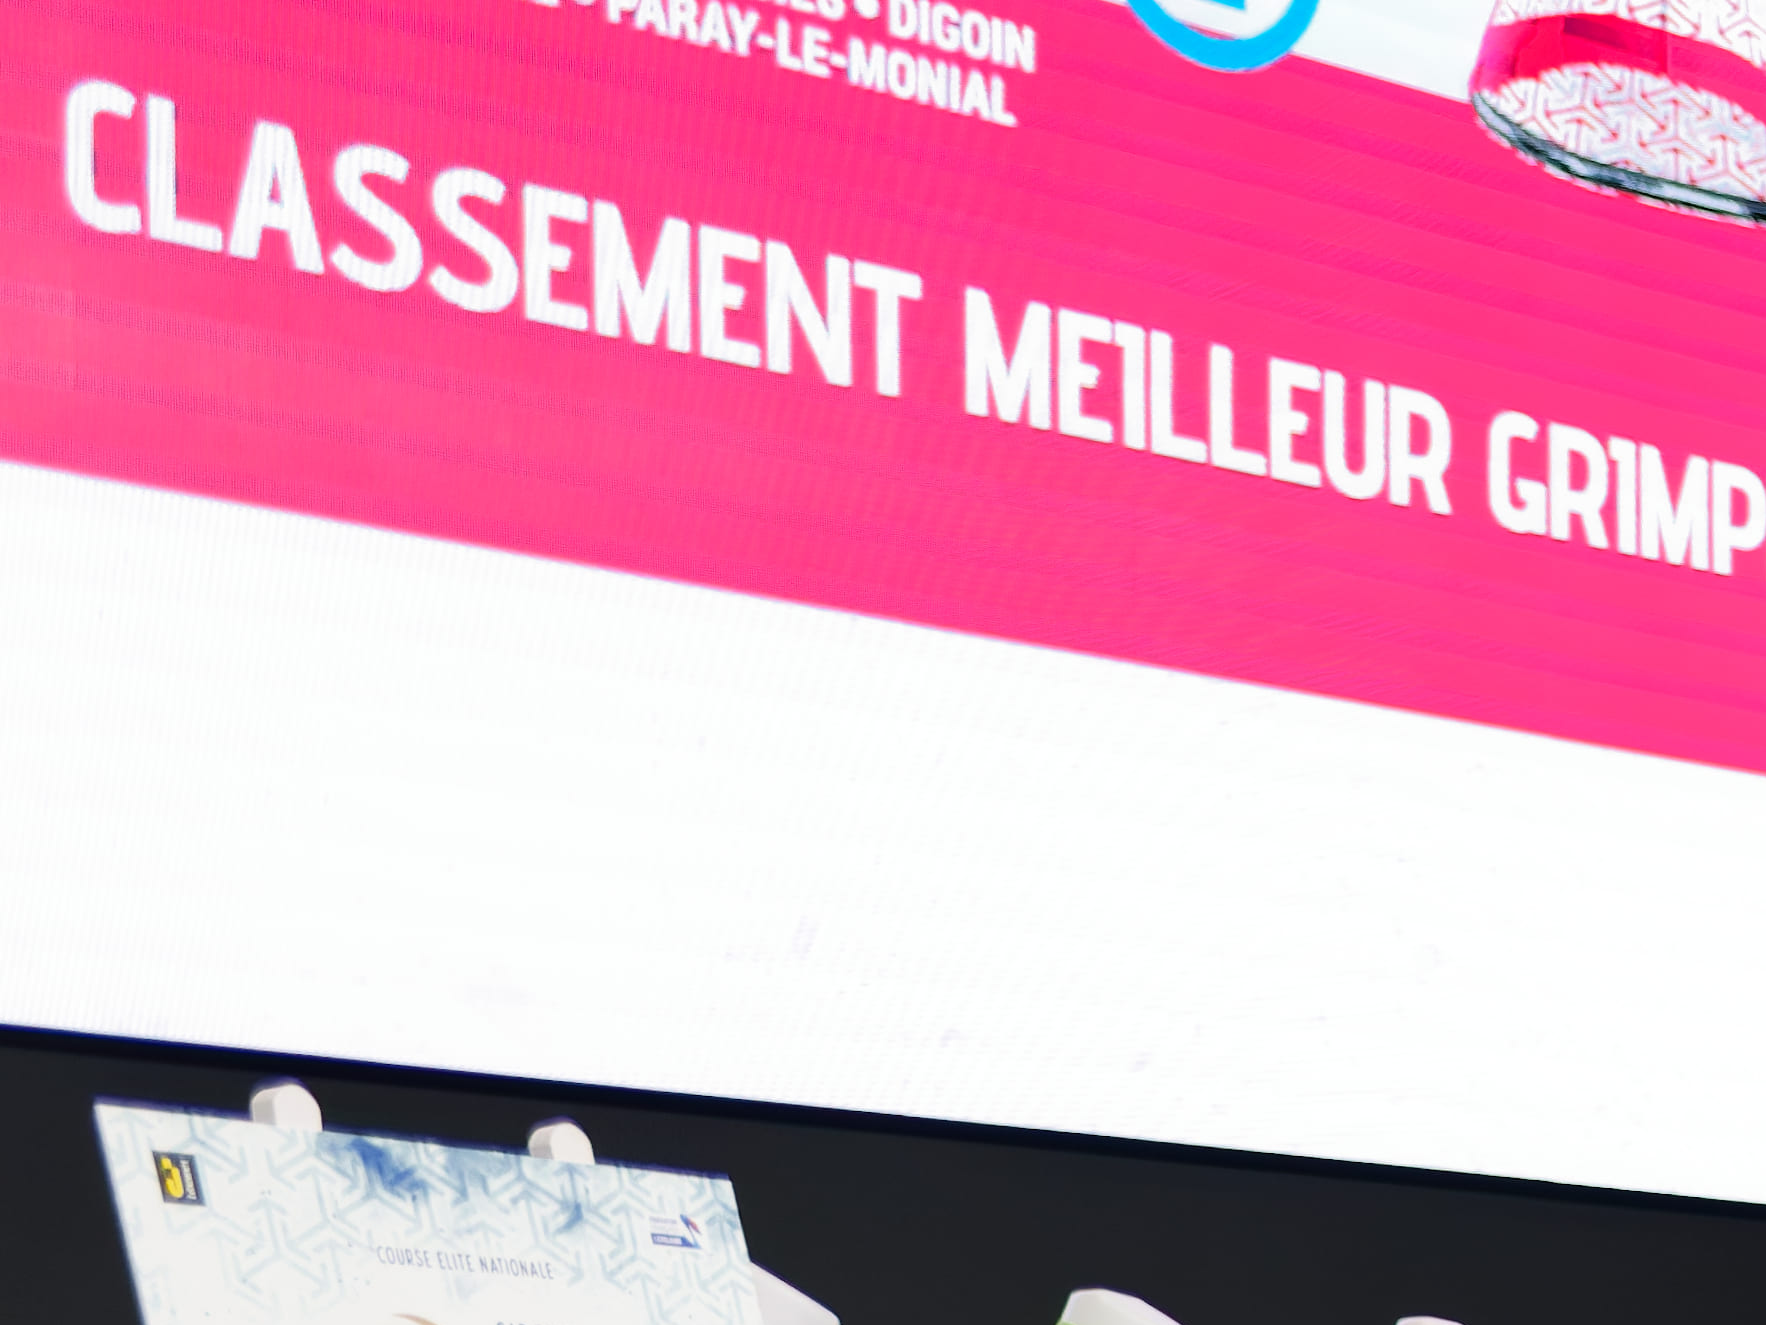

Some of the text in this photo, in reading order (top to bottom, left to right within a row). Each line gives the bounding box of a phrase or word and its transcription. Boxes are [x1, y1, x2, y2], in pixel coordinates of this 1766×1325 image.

[888, 0, 1037, 73] DIGOIN
[62, 79, 921, 398] CLASSEMENT
[962, 285, 1452, 516] MEILLEUR
[377, 1246, 432, 1269] COURSE
[478, 1255, 554, 1279] NATIONALE
